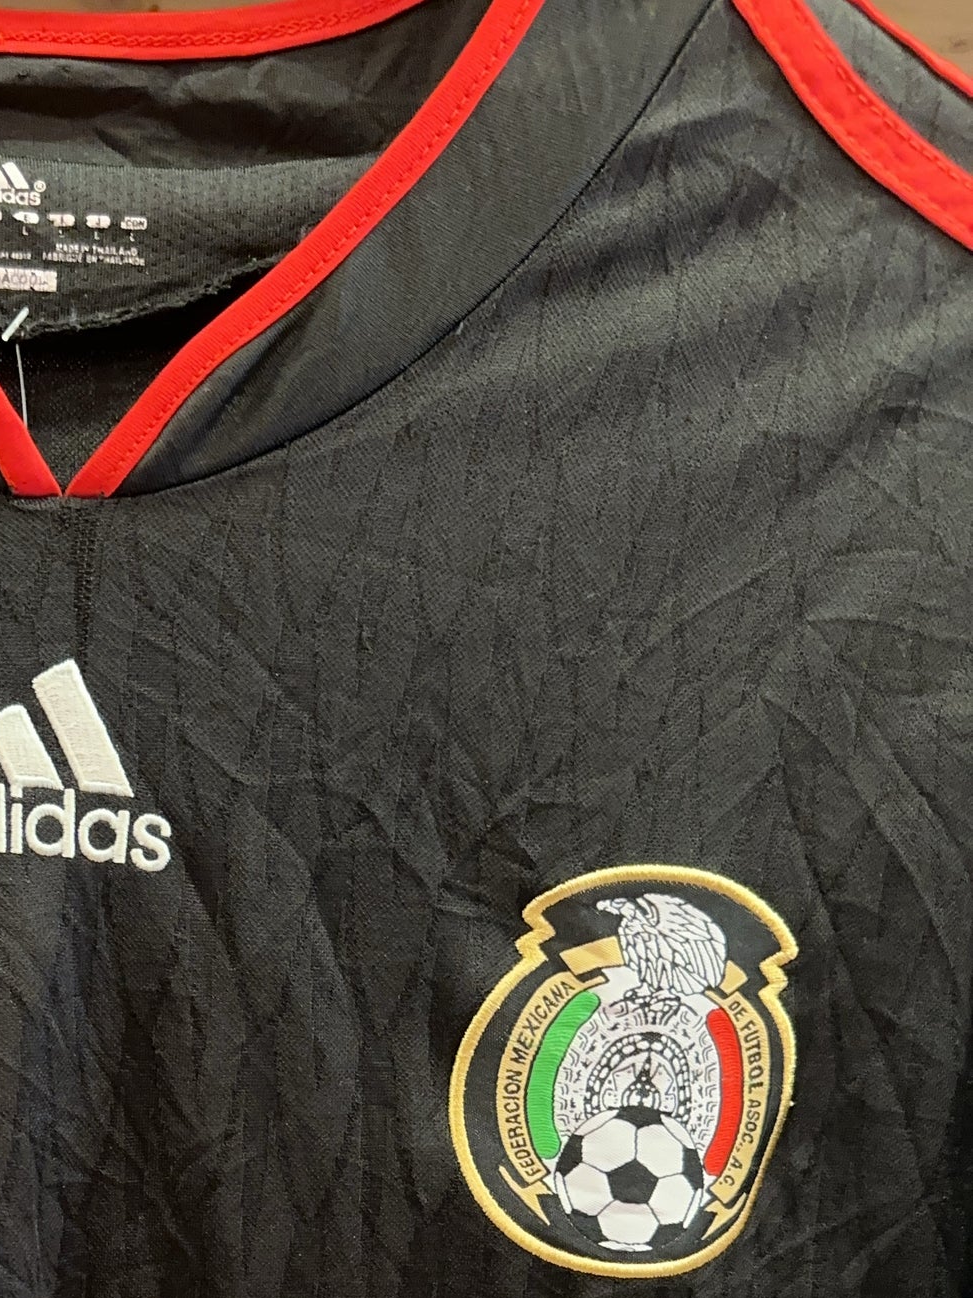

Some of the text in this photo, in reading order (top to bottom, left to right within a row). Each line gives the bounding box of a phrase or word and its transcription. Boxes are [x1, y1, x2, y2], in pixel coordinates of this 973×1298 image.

[510, 981, 576, 1065] MEXICANA
[728, 1001, 748, 1022] DE
[740, 1020, 764, 1094] FUTBOL
[504, 1069, 541, 1177] FEDERACION
